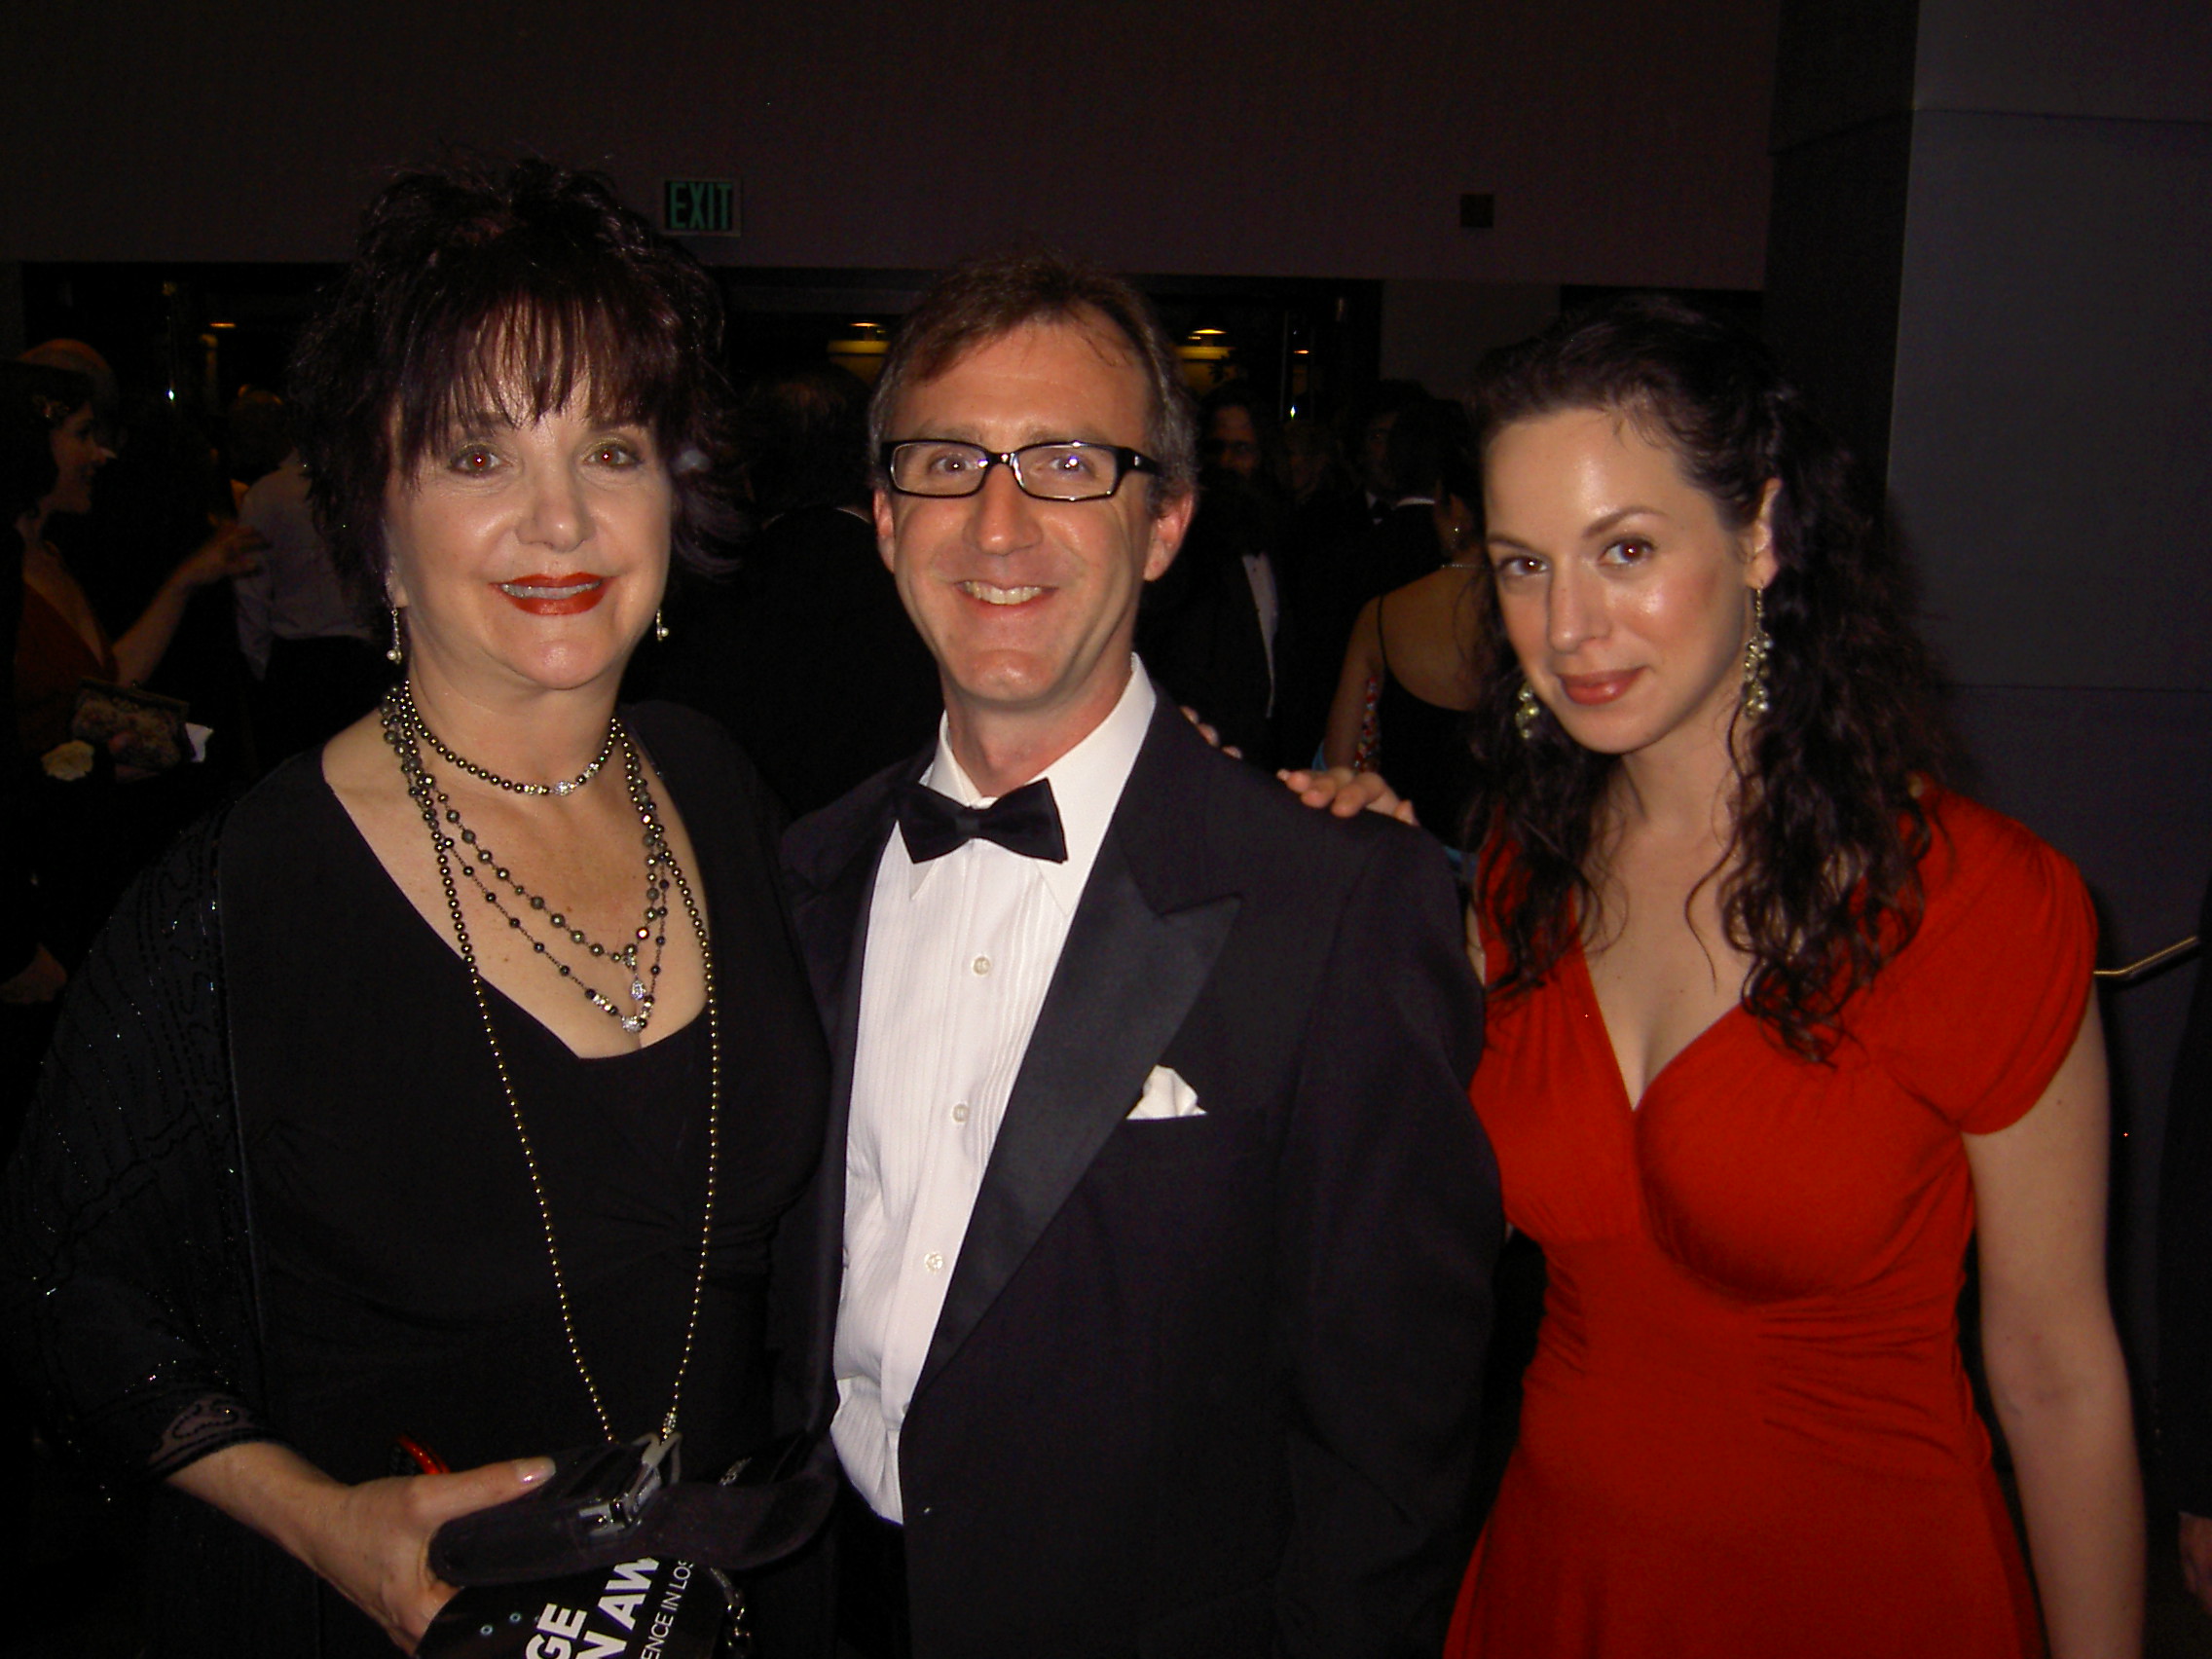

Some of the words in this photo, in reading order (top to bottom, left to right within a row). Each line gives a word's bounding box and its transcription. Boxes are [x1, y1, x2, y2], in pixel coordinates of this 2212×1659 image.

[669, 182, 733, 230] EXIT
[661, 1591, 682, 1611] IN
[526, 1603, 588, 1659] GE
